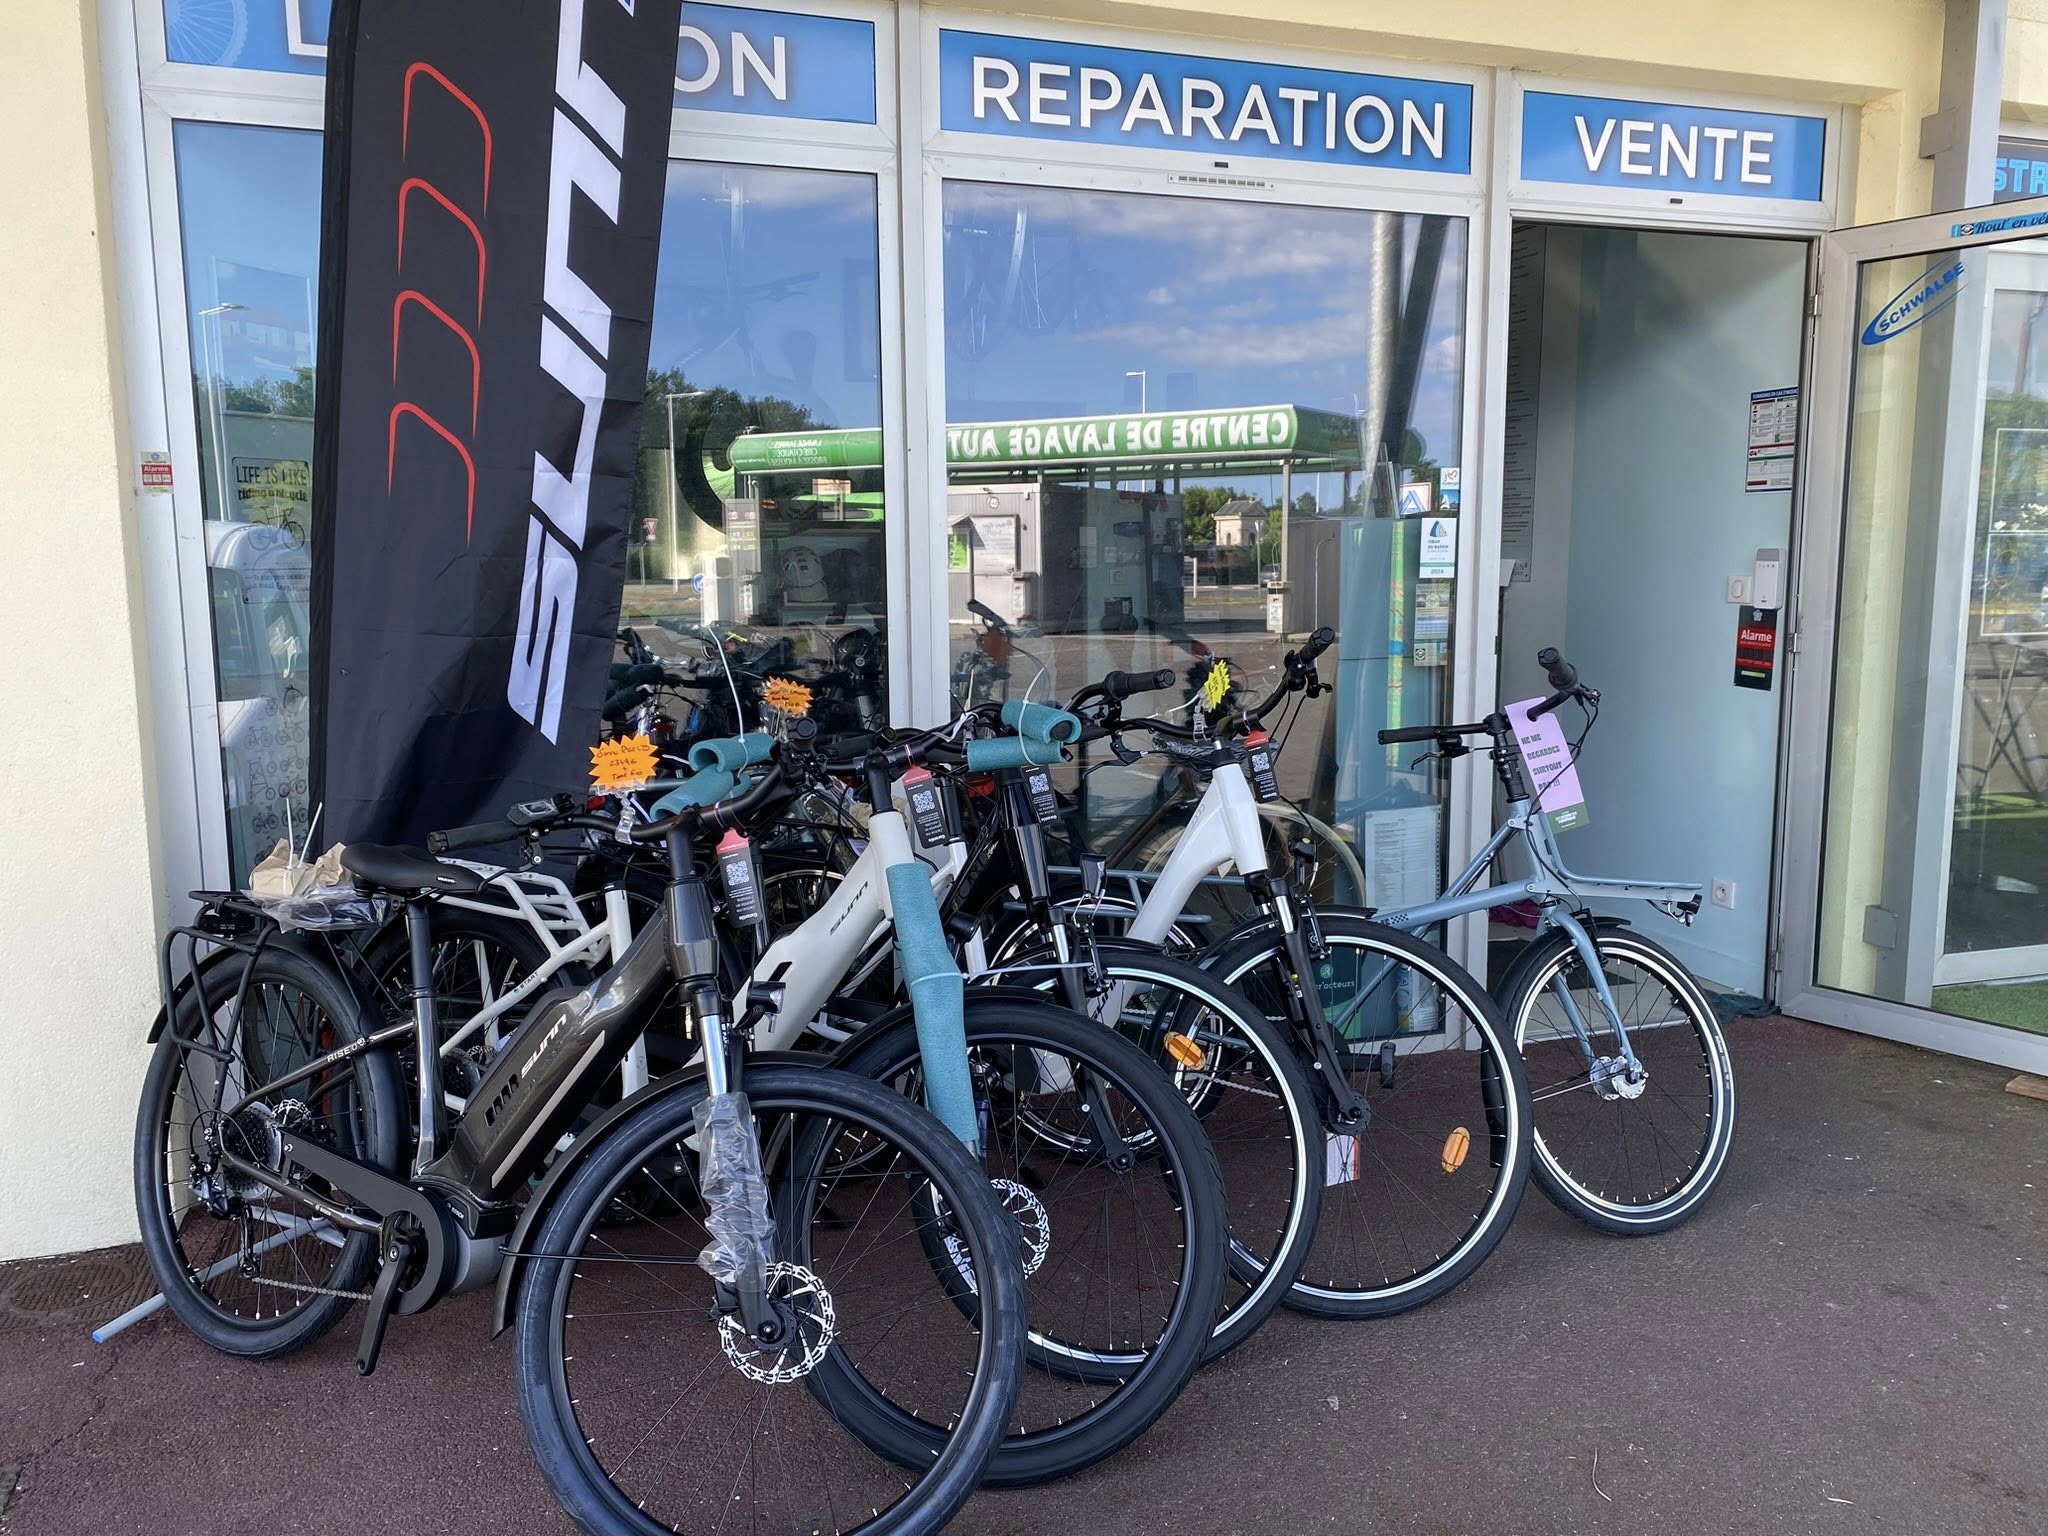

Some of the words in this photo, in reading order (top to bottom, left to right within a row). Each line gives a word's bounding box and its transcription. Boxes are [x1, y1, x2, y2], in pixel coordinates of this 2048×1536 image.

[972, 56, 1444, 159] REPARATION
[1574, 115, 1775, 185] VENTE
[2012, 219, 2026, 230] en
[1880, 262, 1965, 332] SCHWALBE
[236, 466, 262, 483] LIFE
[264, 467, 278, 484] IS
[281, 468, 308, 486] LIKE
[1741, 629, 1772, 642] Alarme
[1532, 761, 1562, 775] SURTOUT
[327, 1047, 350, 1063] RISE
